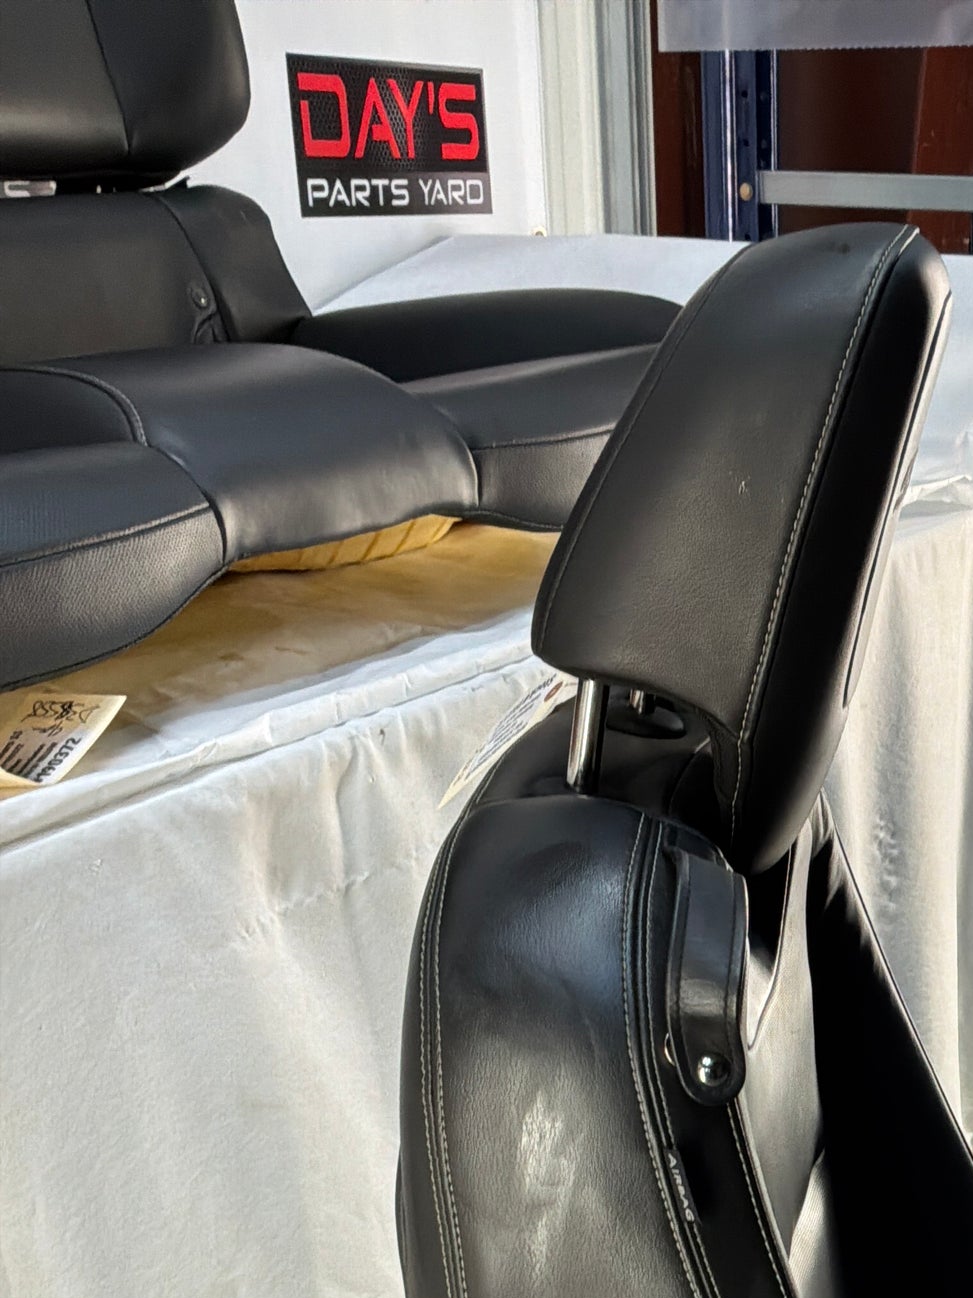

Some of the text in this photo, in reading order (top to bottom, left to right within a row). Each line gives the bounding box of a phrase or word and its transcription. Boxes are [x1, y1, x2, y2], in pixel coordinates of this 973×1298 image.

[297, 72, 480, 160] DAY'S
[306, 177, 484, 208] PARTS YARD
[668, 1152, 695, 1222] AIRBAG
